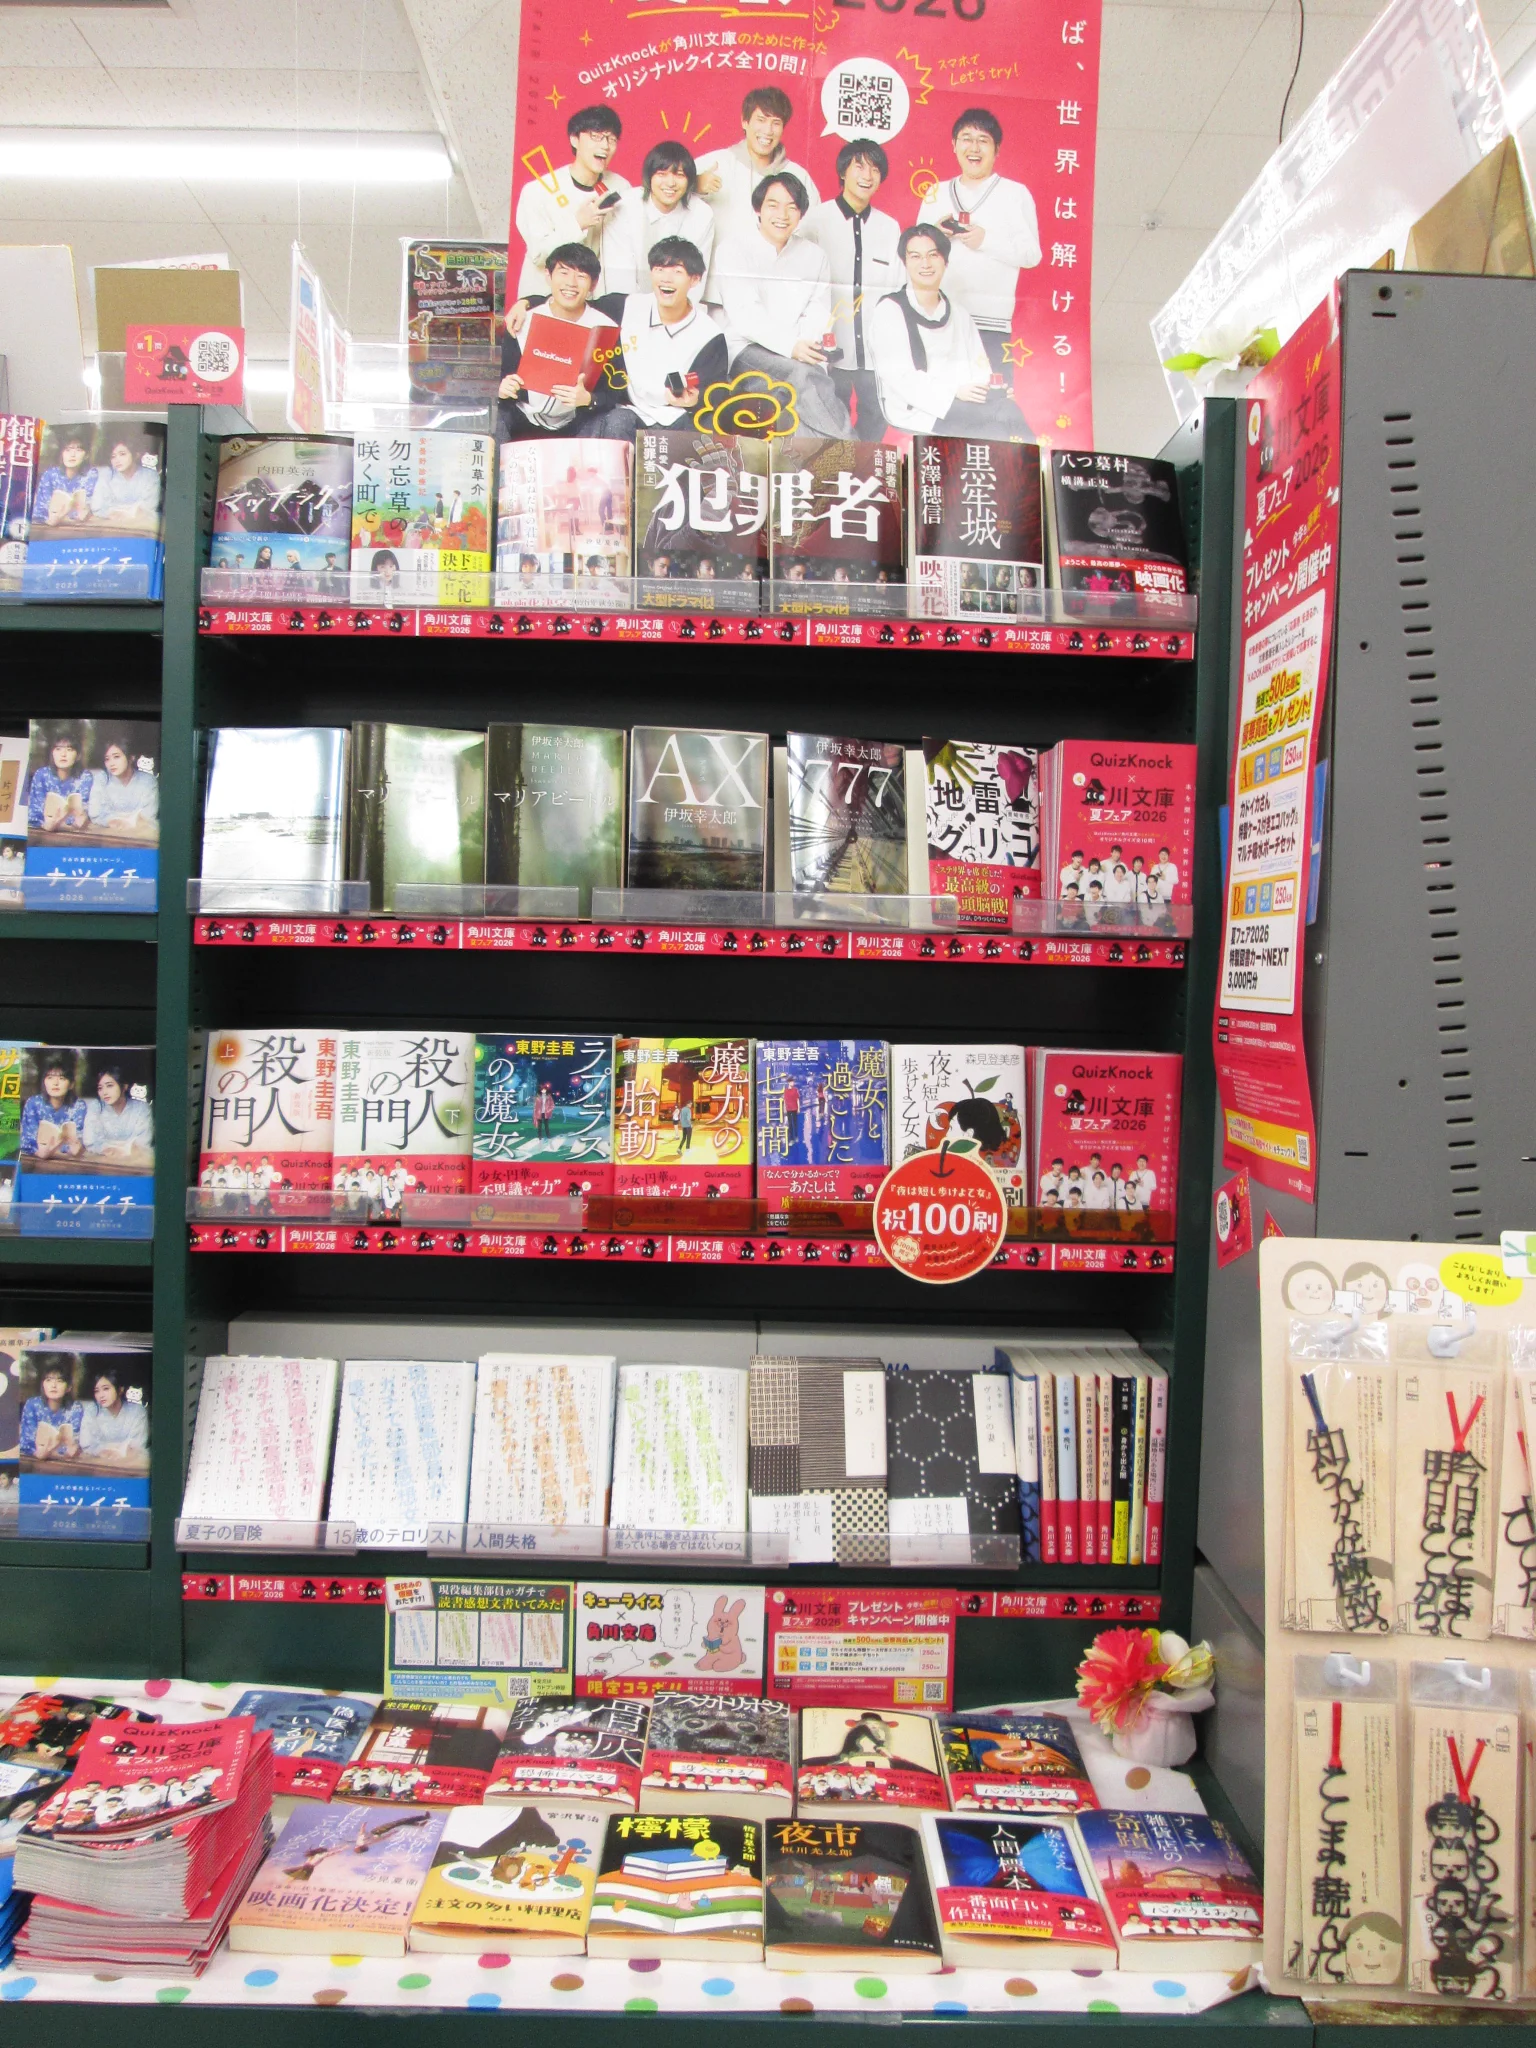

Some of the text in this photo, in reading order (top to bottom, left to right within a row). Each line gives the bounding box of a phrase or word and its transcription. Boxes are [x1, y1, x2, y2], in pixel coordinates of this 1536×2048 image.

[577, 30, 828, 85] QuizKnockが角川文庫のために作った
[601, 50, 807, 99] オリジナルクイズ全10問!
[532, 348, 574, 366] QuizKnock
[642, 435, 657, 473] 犯罪者
[470, 438, 486, 497] 夏川草介
[884, 450, 898, 489] 犯罪者
[1058, 453, 1130, 474] 八つ墓村
[356, 438, 380, 524] 咲く町で
[388, 438, 411, 532] 勿忘草の
[920, 445, 943, 526] 米澤穂信
[1060, 474, 1110, 490] 横溝正史
[652, 462, 892, 542] 犯罪者
[958, 442, 1001, 551] 黒牢城
[46, 556, 133, 577] ナツイチ
[1245, 539, 1291, 596] プレゼント
[918, 559, 944, 618] 映画化
[1134, 569, 1186, 593] 映画化
[1244, 540, 1333, 629] キャンペーン開催中
[225, 610, 274, 624] 角川文庫
[423, 613, 473, 626] 角川文庫
[613, 617, 664, 631] 角川文庫
[227, 623, 272, 633] 夏フェア2026
[426, 625, 471, 634] 夏フェア2026
[616, 630, 662, 640] 夏フェア2026
[814, 623, 863, 636] 角川文庫
[1004, 629, 1053, 642] 角川文庫
[817, 635, 861, 645] 夏フェア2026
[1007, 641, 1051, 651] 夏フェア2026
[531, 735, 585, 750] 伊坂幸太郎
[815, 741, 883, 762] 伊坂幸太郎
[1090, 752, 1174, 770] QuizKnock
[634, 733, 765, 809] AX
[803, 758, 893, 808] 777
[493, 788, 616, 808] マリアビートル
[932, 780, 1001, 816] 地雷
[663, 807, 738, 825] 伊坂幸太郎
[1089, 807, 1168, 823] 夏フェア2026
[937, 822, 1033, 860] グリコ
[46, 867, 140, 888] ナツイチ
[944, 877, 1001, 896] 最高級の
[268, 922, 317, 935] 角川文庫
[467, 925, 515, 938] 角川文庫
[657, 930, 707, 943] 角川文庫
[1230, 924, 1270, 945] 夏フェア2026
[271, 934, 316, 944] 夏フェア2026
[470, 938, 514, 948] 夏フェア2026
[661, 942, 705, 952] 夏フェア2026
[856, 936, 904, 949] 角川文庫
[1045, 941, 1094, 954] 角川文庫
[858, 947, 903, 958] 夏フェア2026
[1047, 953, 1091, 963] 夏フェア2026
[1229, 947, 1290, 968] 特製図書カードNEXT
[1227, 971, 1259, 991] 3,000円分
[220, 1044, 235, 1059] 上
[515, 1039, 576, 1056] 東野圭吾
[622, 1048, 680, 1064] 東野圭吾
[762, 1046, 820, 1063] 東野圭吾
[964, 1052, 1021, 1066] 森見登美彦
[314, 1037, 337, 1121] 東野圭吾
[1071, 1064, 1154, 1080] QuizKnock
[340, 1039, 362, 1124] 東野圭吾
[920, 1050, 953, 1114] 夜は短し
[567, 1040, 612, 1162] ラプラス
[701, 1041, 750, 1158] 魔力の
[855, 1047, 888, 1142] 魔女と
[900, 1057, 921, 1139] 歩けよ乙女
[444, 1108, 461, 1125] 下
[475, 1057, 520, 1160] の魔女
[756, 1066, 790, 1157] 七日間
[822, 1061, 854, 1163] 過ごした
[617, 1079, 661, 1160] 胎動
[1070, 1117, 1147, 1132] 夏フェア2026
[281, 1159, 333, 1170] QuizKnock
[414, 1161, 467, 1173] QuizKnock
[566, 1169, 606, 1178] QuizKnock
[704, 1170, 742, 1179] QuizKnock
[890, 1183, 993, 1200] 『夜は短し歩けよ乙女』
[42, 1194, 137, 1216] ナツイチ
[56, 1219, 82, 1228] 2026
[881, 1202, 999, 1236] 祝100刷
[289, 1229, 338, 1242] 角川文庫
[478, 1234, 527, 1247] 角川文庫
[292, 1241, 336, 1251] 夏フェア2026
[481, 1246, 525, 1256] 夏フェア2026
[676, 1239, 724, 1252] 角川文庫
[1059, 1248, 1107, 1260] 角川文庫
[678, 1251, 722, 1261] 夏フェア2026
[1062, 1259, 1105, 1269] 夏フェア2026
[1456, 1271, 1507, 1288] よろしくお願い
[854, 1382, 864, 1417] こころ
[982, 1383, 997, 1444] ヴィヨンの妻
[39, 1493, 131, 1517] ナツイチ
[52, 1520, 78, 1530] 2026
[185, 1524, 264, 1541] 夏子の冒険
[333, 1527, 458, 1546] 15歳のテロリスト
[473, 1532, 538, 1550] 人間失格
[1047, 1524, 1056, 1557] 角川文庫
[1064, 1524, 1073, 1557] 角川文庫
[1085, 1524, 1094, 1557] 角川文庫
[614, 1541, 743, 1552] 走っている場合ではないメロス
[238, 1579, 286, 1591] 角川文庫
[438, 1584, 545, 1598] 現役編集部員がガチで
[241, 1590, 284, 1599] 夏フェア2026
[583, 1591, 665, 1610] キューライス
[1001, 1595, 1047, 1607] 角川文庫
[438, 1596, 566, 1611] 読書感想文書いてみた!
[848, 1601, 904, 1614] プレゼント
[1003, 1606, 1045, 1616] 夏フェア2026
[782, 1616, 842, 1627] 夏フェア2026
[847, 1614, 951, 1627] キャンペーン開催中
[586, 1621, 657, 1642] 角川文庫
[653, 1690, 791, 1718] テスカトリポカ
[123, 1722, 224, 1738] QuizKnock
[545, 1811, 600, 1824] 宮沢賢治
[615, 1816, 713, 1841] 檸檬
[772, 1821, 863, 1848] 夜市
[1173, 1814, 1207, 1855] ナミヤ
[779, 1845, 854, 1858] 恒川光太郎
[990, 1823, 1033, 1891] 人間標本
[247, 1890, 414, 1918] 映画化決定!
[424, 1897, 584, 1921] 注文の多い料理店
[944, 1893, 1050, 1912] 一番面白い
[1062, 1919, 1103, 1934] 夏フェア
